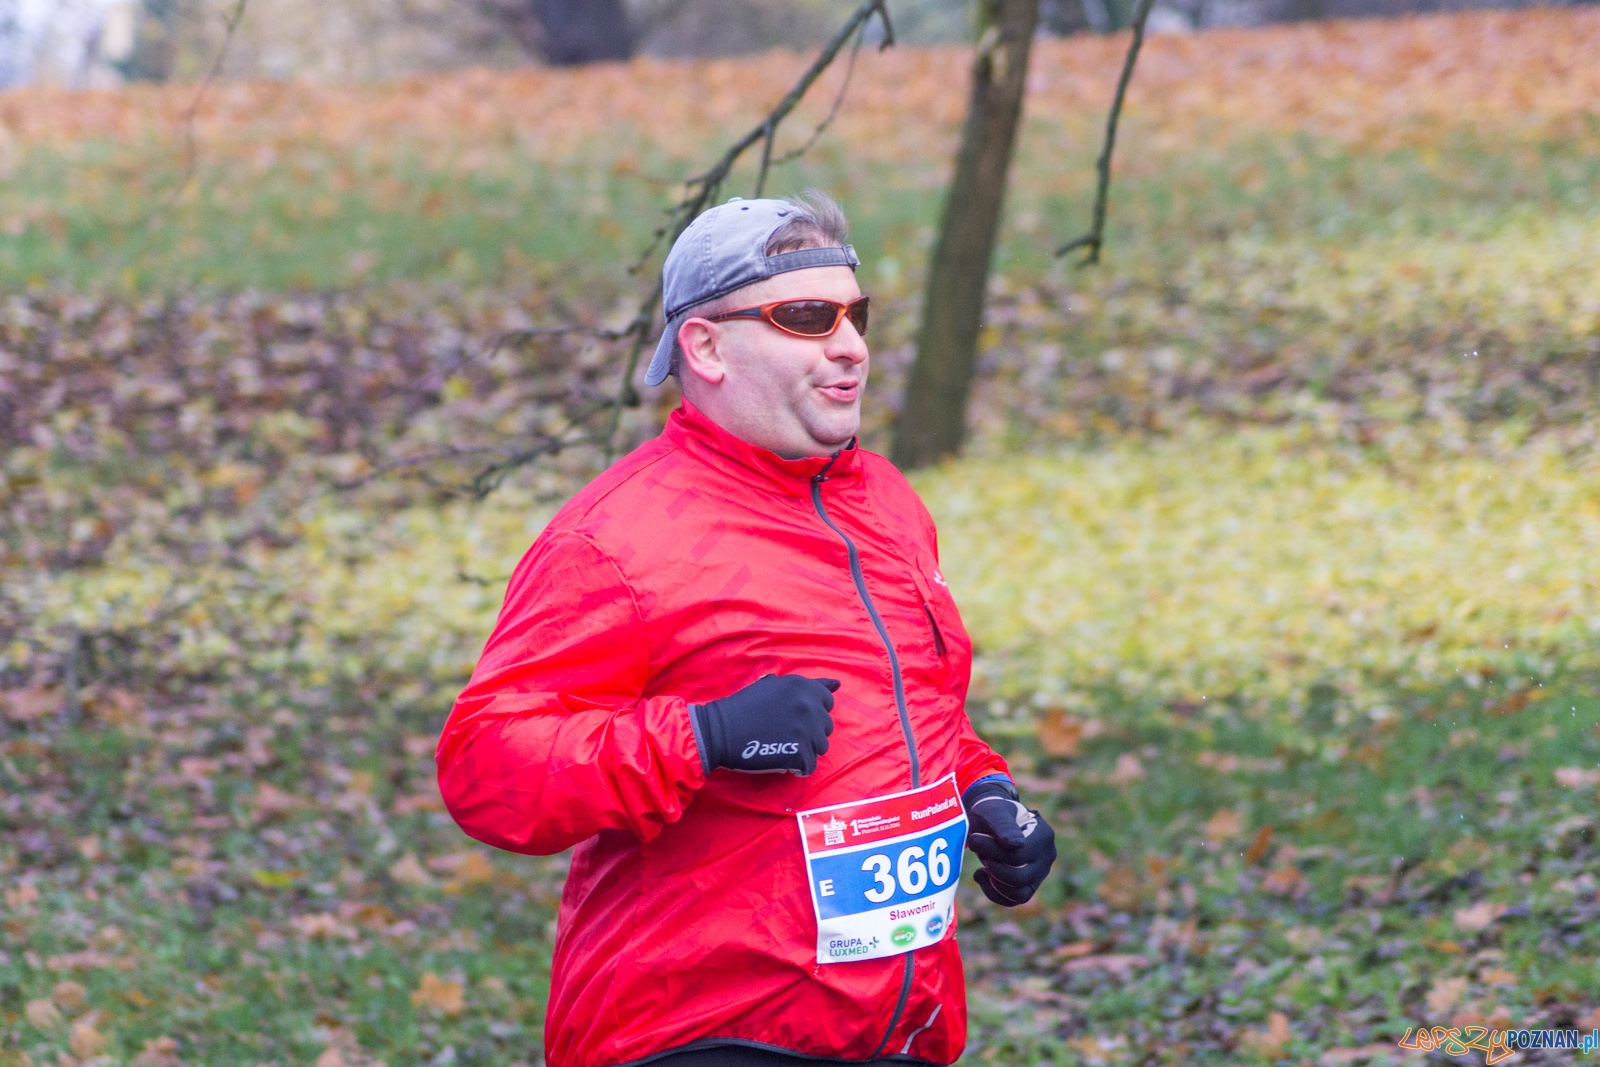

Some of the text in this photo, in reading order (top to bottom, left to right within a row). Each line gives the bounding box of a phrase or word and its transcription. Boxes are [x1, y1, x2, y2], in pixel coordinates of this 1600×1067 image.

[758, 742, 799, 756] asics
[849, 819, 861, 836] 1
[861, 837, 951, 903] 366
[819, 879, 835, 897] E
[889, 900, 936, 921] Sławomir
[829, 938, 863, 949] GRUPA
[829, 946, 869, 957] LUXMED
